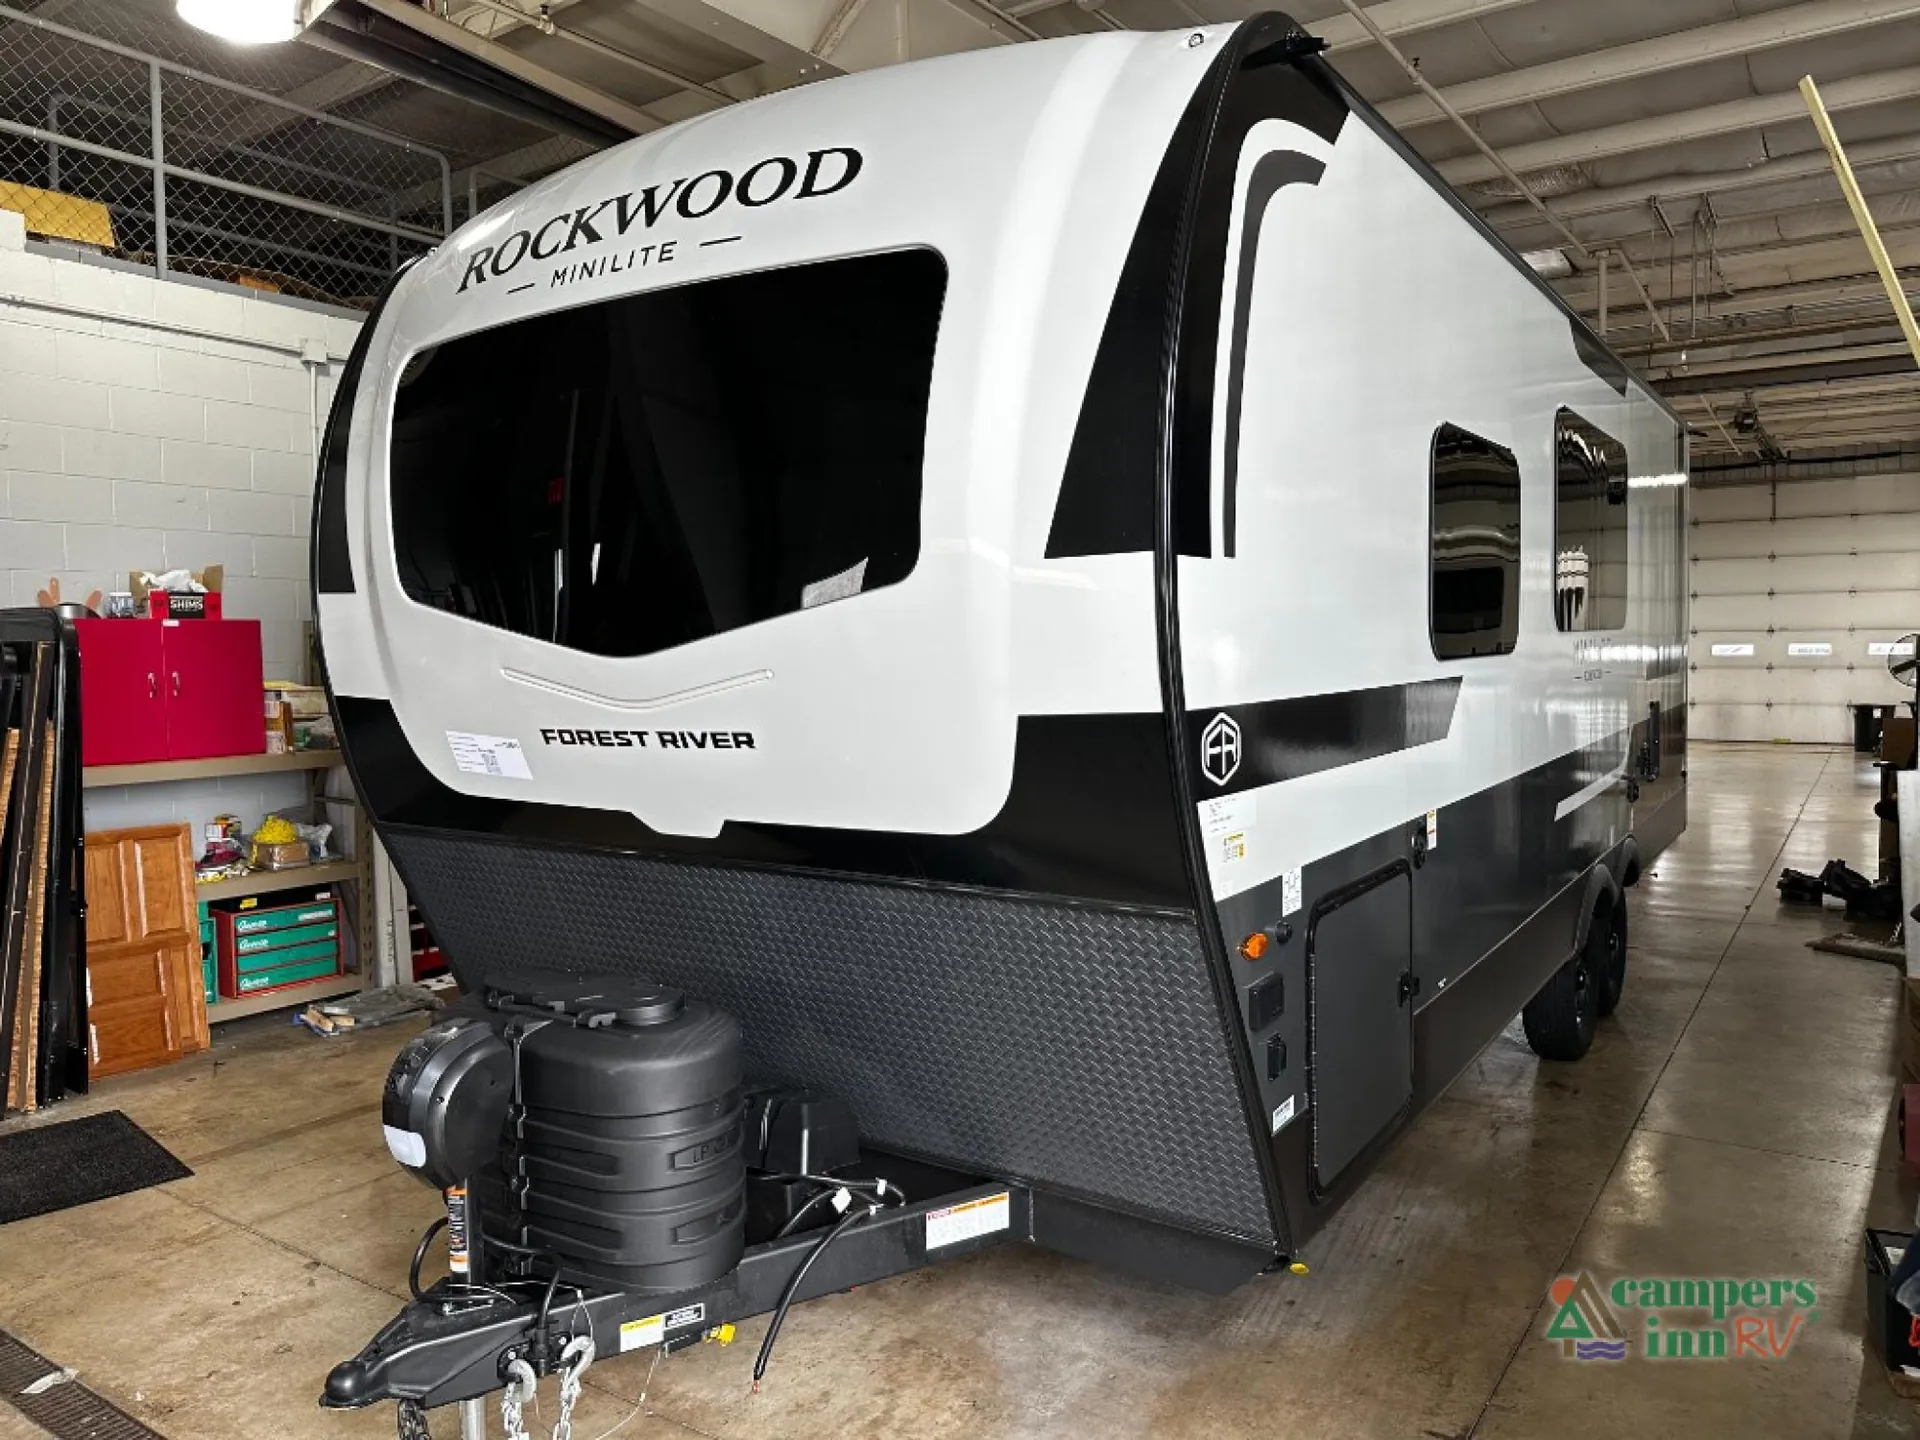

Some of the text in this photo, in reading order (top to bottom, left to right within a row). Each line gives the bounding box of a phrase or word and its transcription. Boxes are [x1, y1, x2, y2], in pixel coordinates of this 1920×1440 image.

[457, 146, 864, 294] ROCKWOOD
[550, 241, 678, 289] MINILITE
[170, 599, 203, 609] SHIMS
[539, 729, 757, 749] FOREST RIVER
